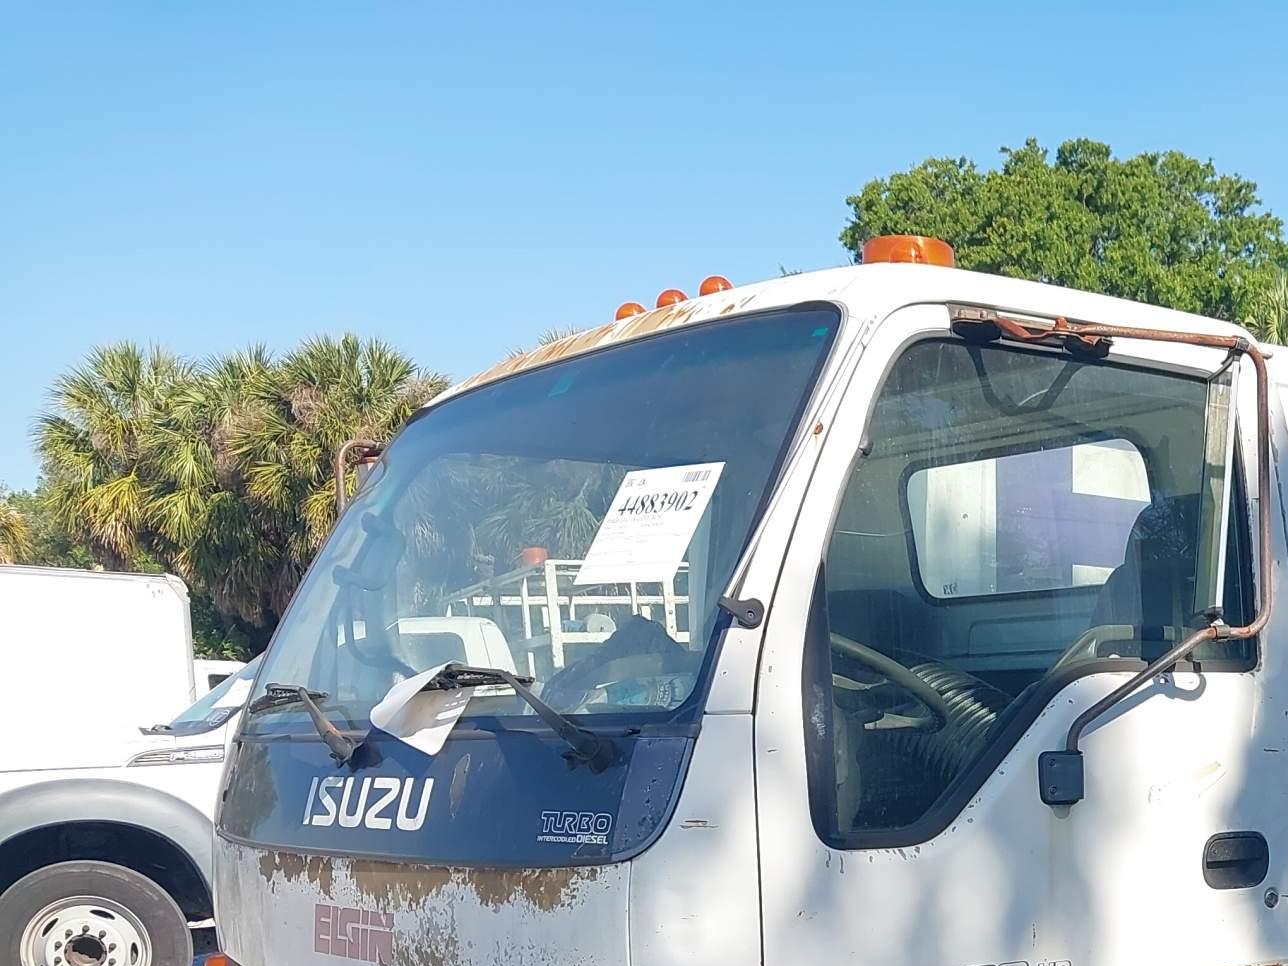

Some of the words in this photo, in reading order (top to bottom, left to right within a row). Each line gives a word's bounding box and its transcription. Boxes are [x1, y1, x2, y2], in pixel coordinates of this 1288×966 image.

[618, 490, 698, 516] 44883902
[302, 776, 435, 831] ISUZU
[541, 811, 612, 835] TURBO
[314, 903, 394, 965] ELGIN
